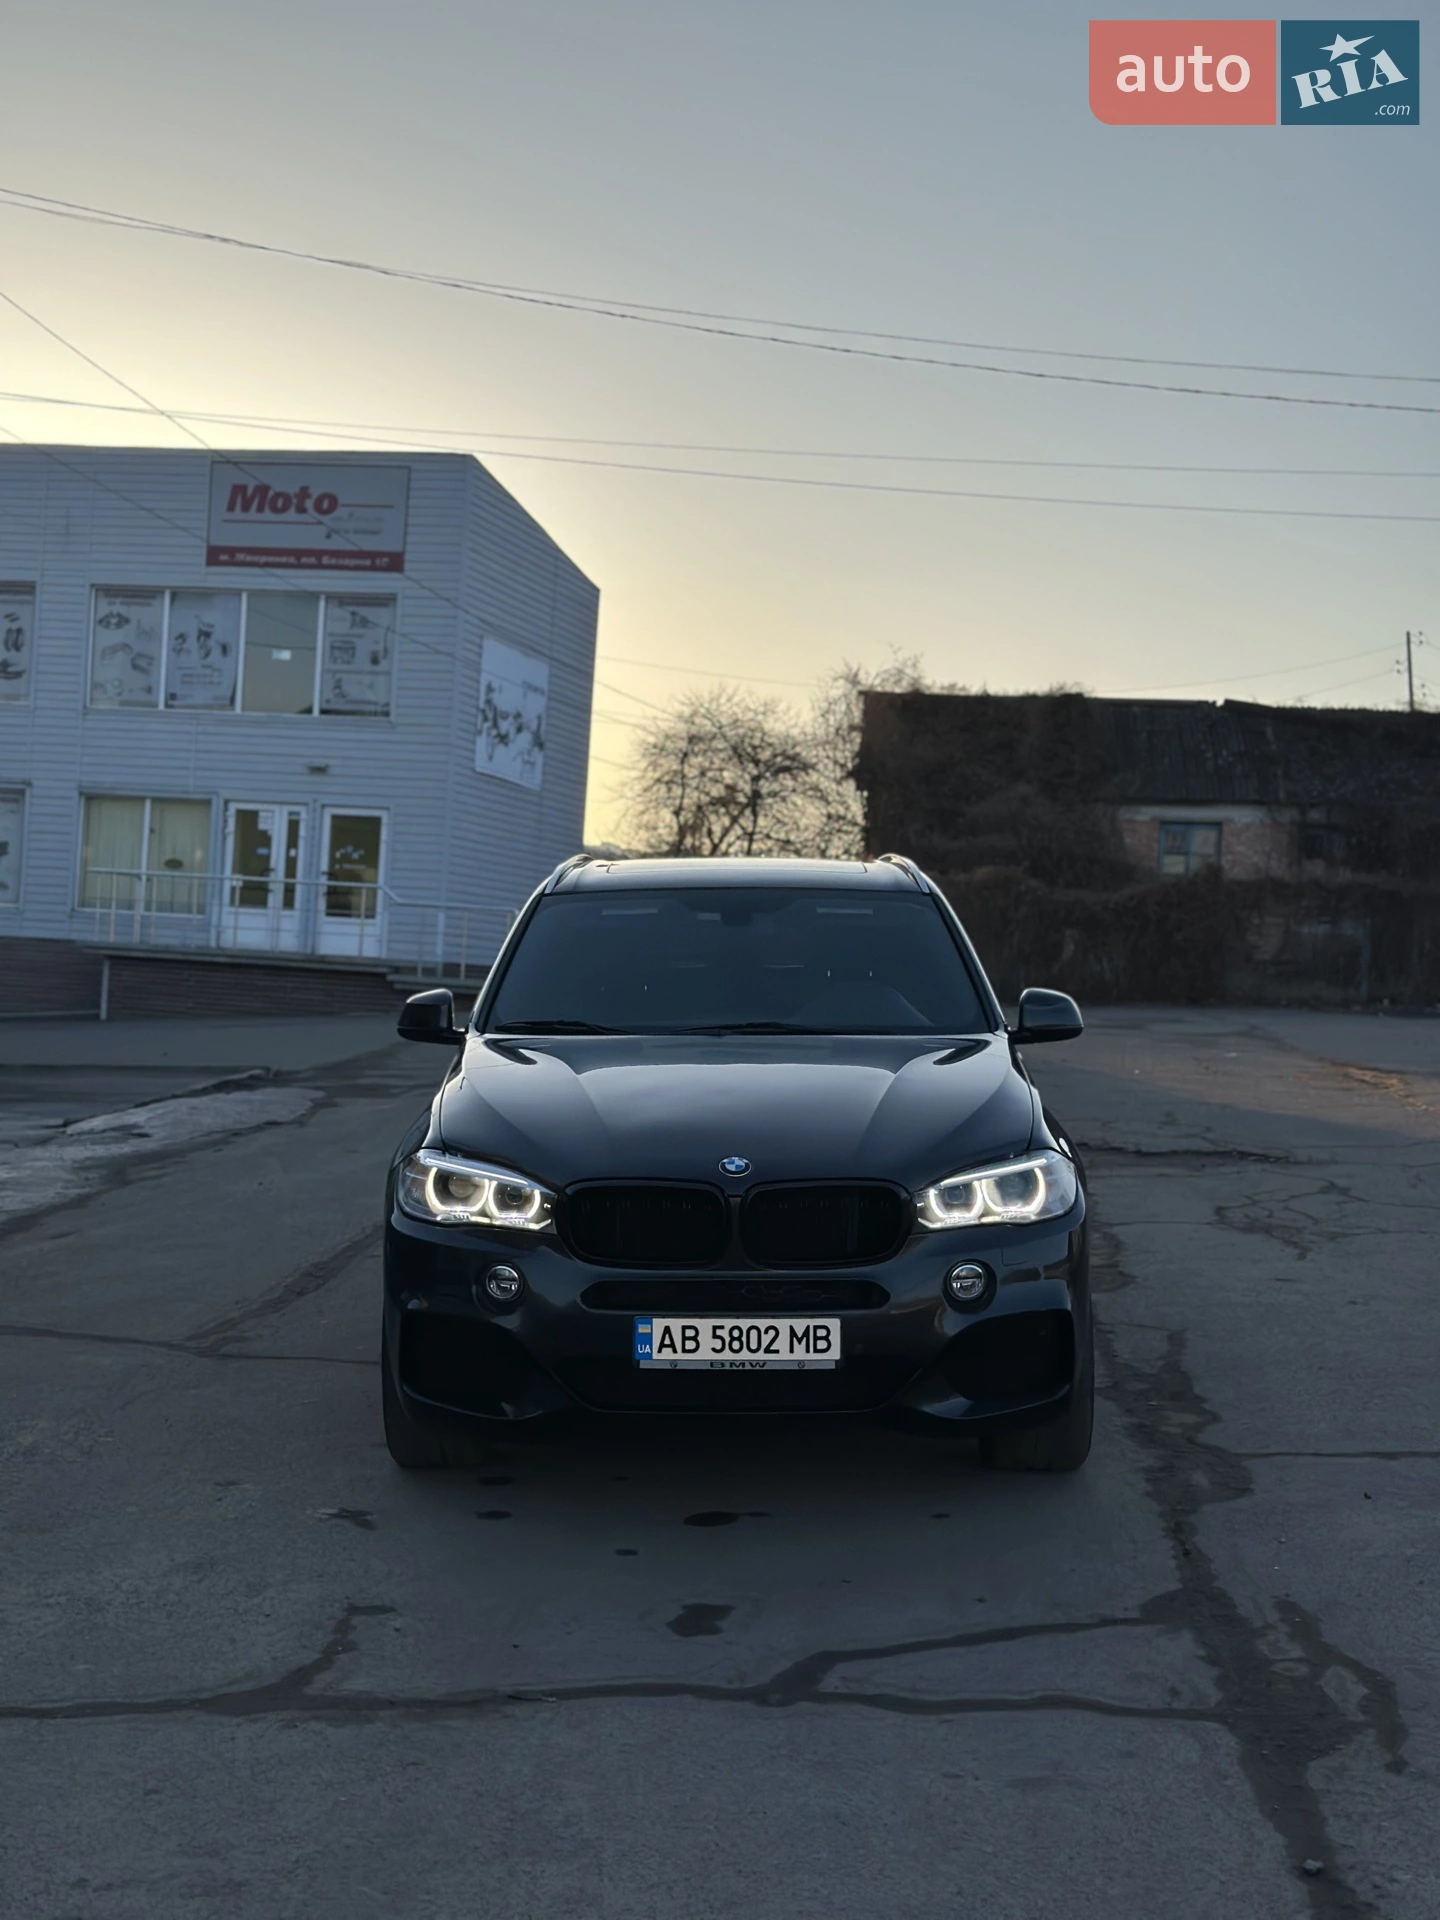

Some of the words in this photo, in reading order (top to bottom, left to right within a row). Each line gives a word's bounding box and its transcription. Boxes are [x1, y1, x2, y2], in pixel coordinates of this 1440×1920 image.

[225, 483, 339, 516] Moto
[638, 1344, 651, 1353] UA
[657, 1325, 701, 1354] AB
[710, 1325, 780, 1354] 5802
[789, 1325, 832, 1353] MB
[710, 1361, 767, 1369] BMW
